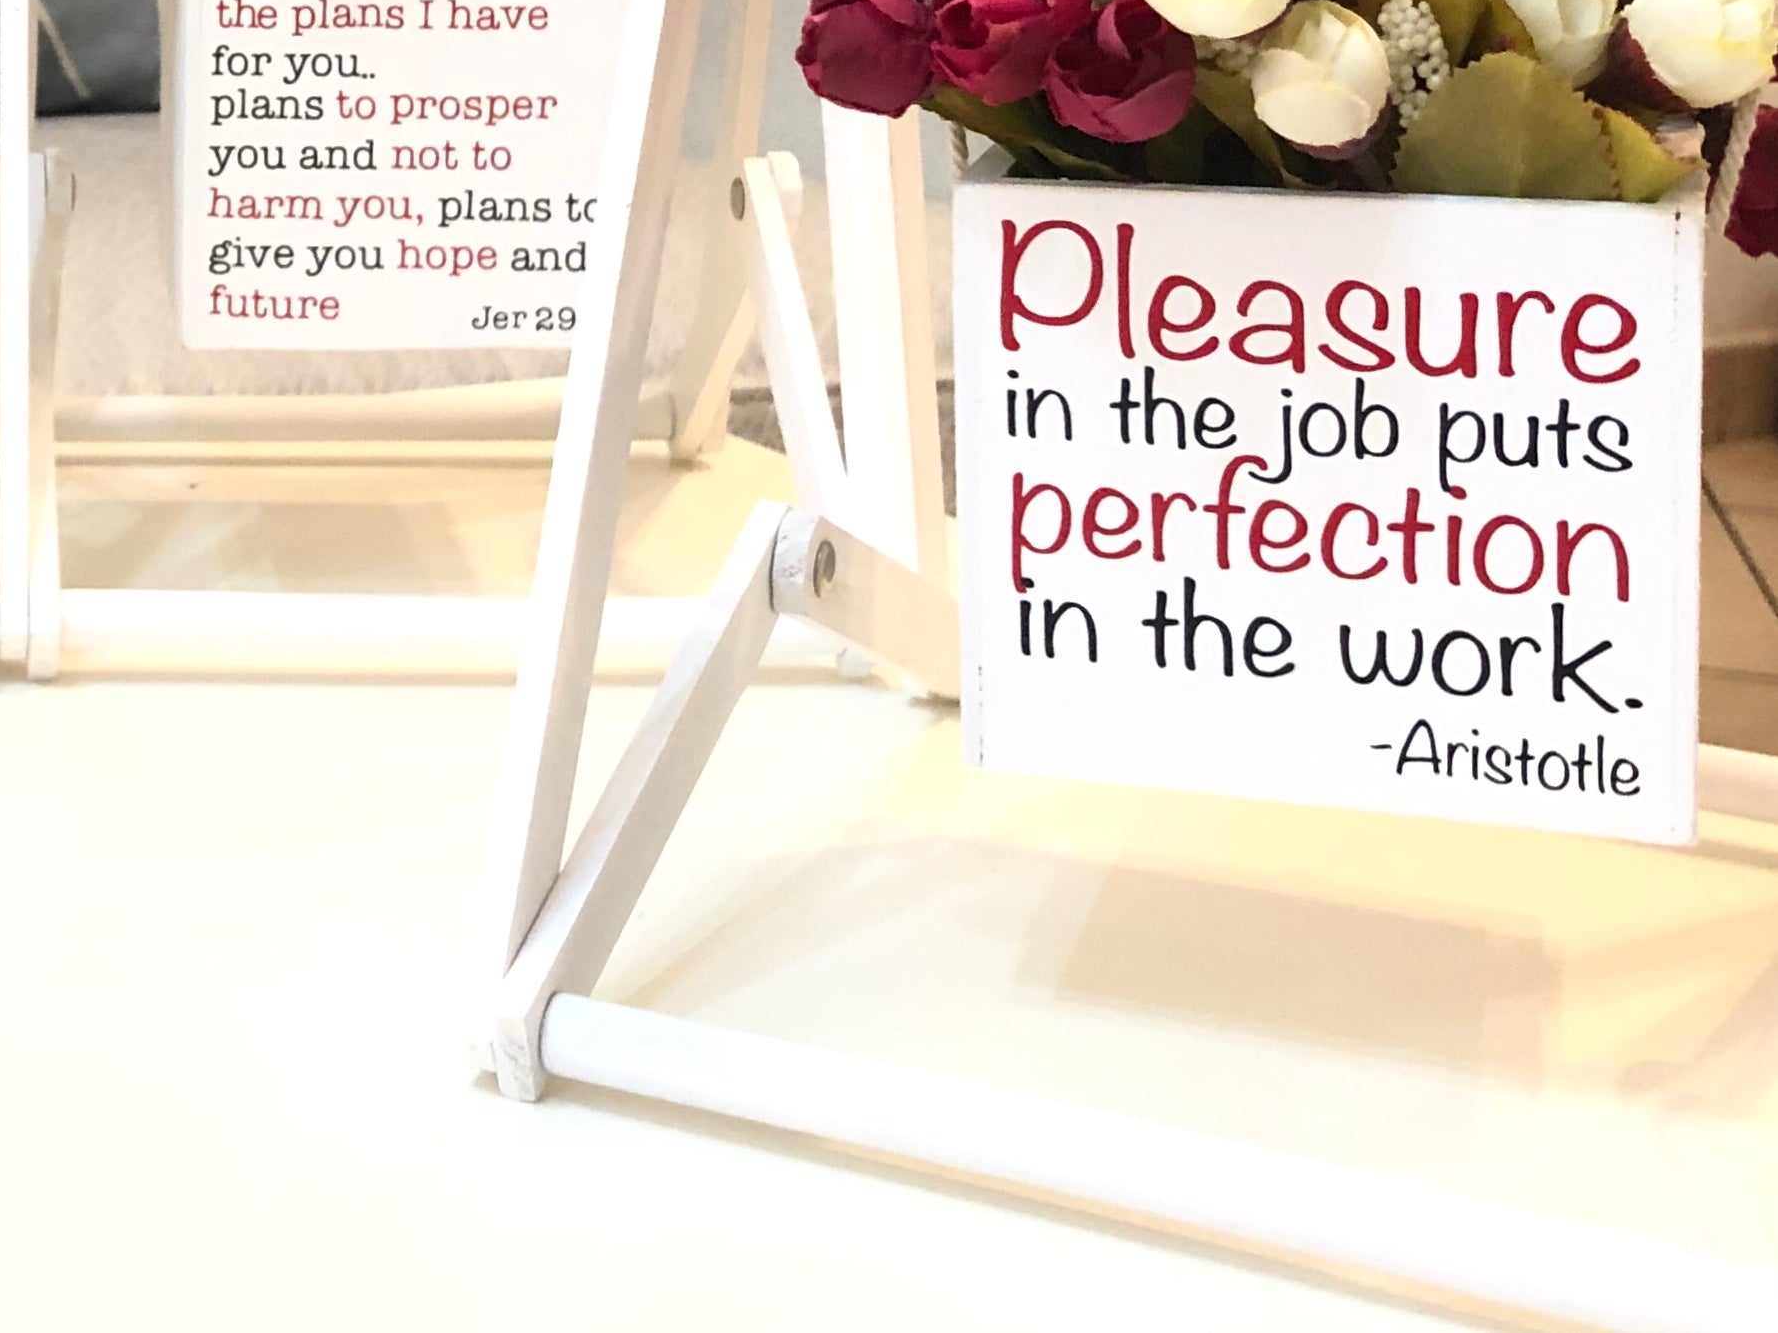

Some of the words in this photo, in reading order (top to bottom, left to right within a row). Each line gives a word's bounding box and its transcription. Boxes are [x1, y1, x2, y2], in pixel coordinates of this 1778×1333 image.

[291, 0, 405, 36] plans
[418, 0, 434, 30] I
[447, 0, 550, 32] have
[210, 45, 271, 77] for
[282, 51, 377, 85] you..
[210, 89, 324, 125] plans
[336, 89, 377, 120] to
[390, 93, 558, 125] prosper
[207, 143, 287, 176] you
[299, 140, 378, 170] and
[390, 141, 459, 171] not
[473, 141, 512, 171] to
[207, 188, 323, 220] harm
[334, 194, 424, 228] you,
[438, 190, 553, 227] plans
[208, 237, 296, 275] give
[305, 243, 385, 276] you
[396, 239, 499, 275] hope
[510, 242, 587, 272] and
[208, 284, 342, 320] future
[471, 304, 527, 331] Jer
[535, 306, 577, 331] 29
[997, 216, 1643, 386] Pleasure
[1004, 370, 1073, 441] in
[1108, 366, 1239, 451] the
[1246, 378, 1401, 485] job
[1437, 396, 1635, 495] puts
[1009, 452, 1631, 603] perfection
[1016, 578, 1100, 665] in
[1141, 575, 1297, 679] the
[1337, 602, 1646, 714] work.
[1369, 718, 1643, 798] -Aristotle
